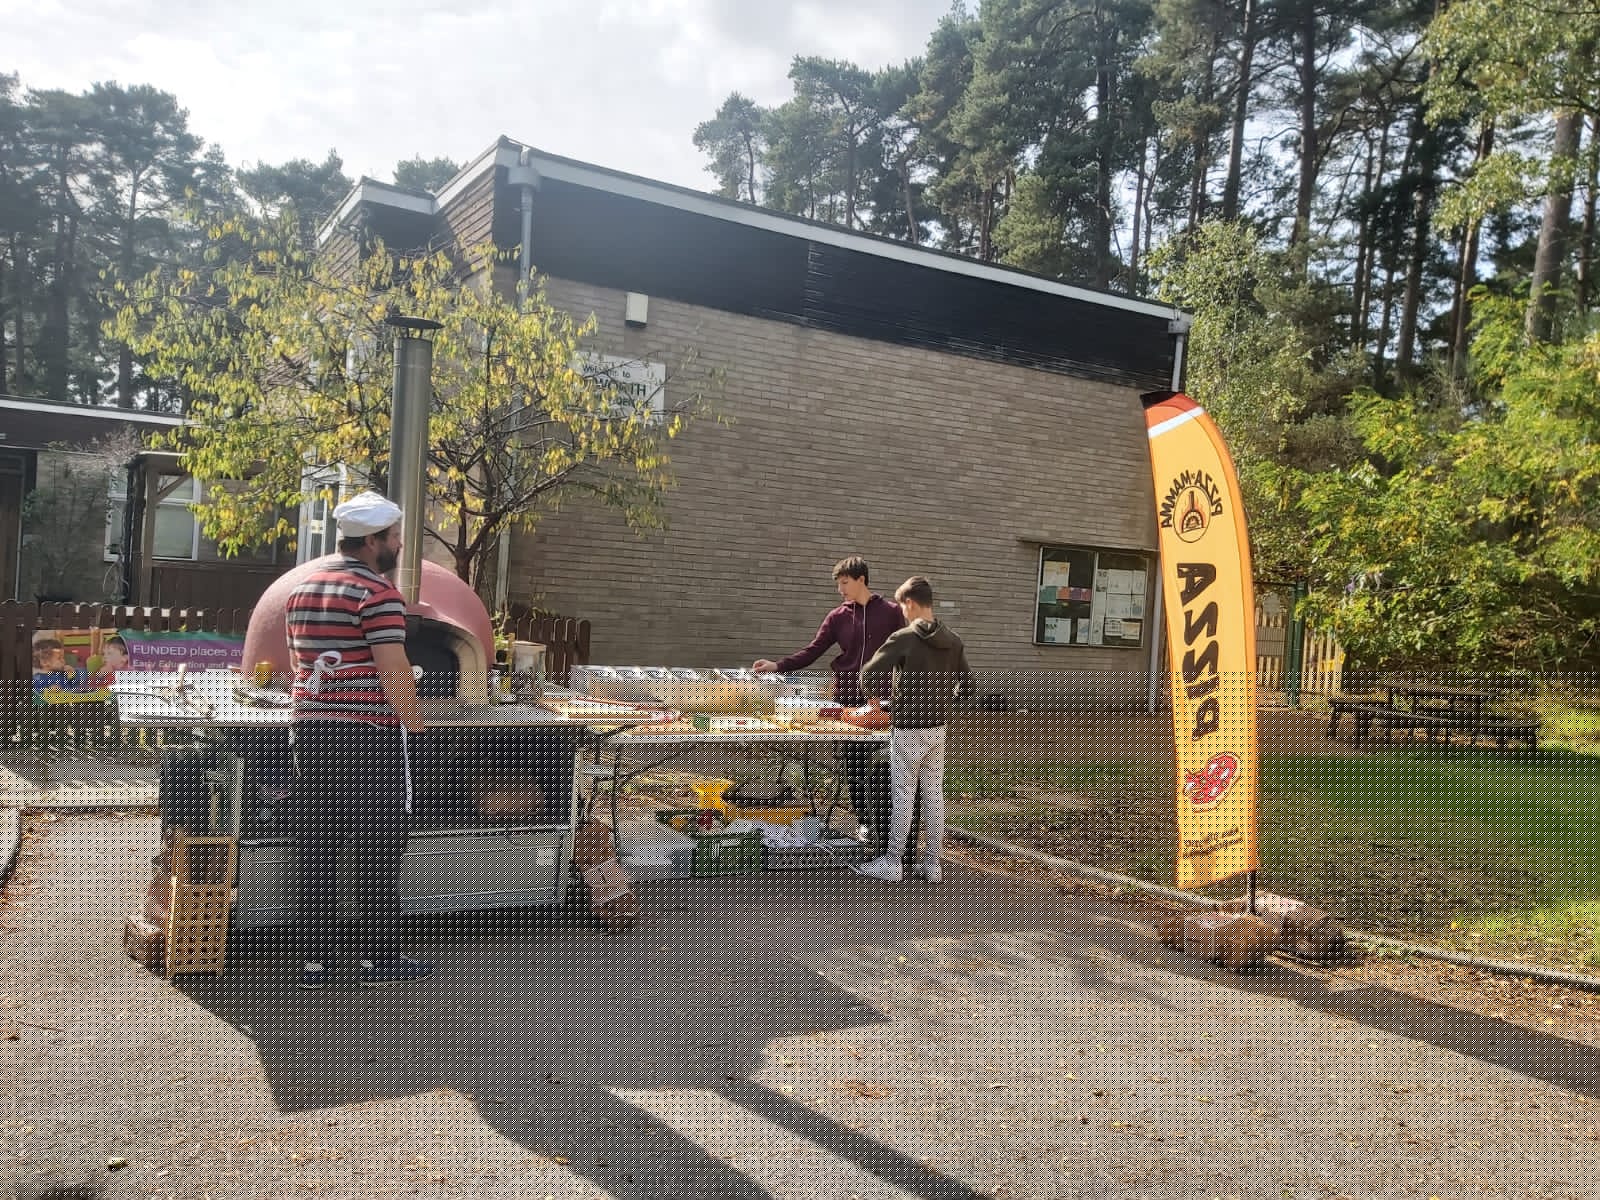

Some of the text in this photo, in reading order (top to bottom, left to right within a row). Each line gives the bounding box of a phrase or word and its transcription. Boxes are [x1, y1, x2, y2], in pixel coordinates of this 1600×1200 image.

[622, 370, 631, 378] to
[133, 644, 187, 657] FUNDED
[190, 647, 228, 657] places
